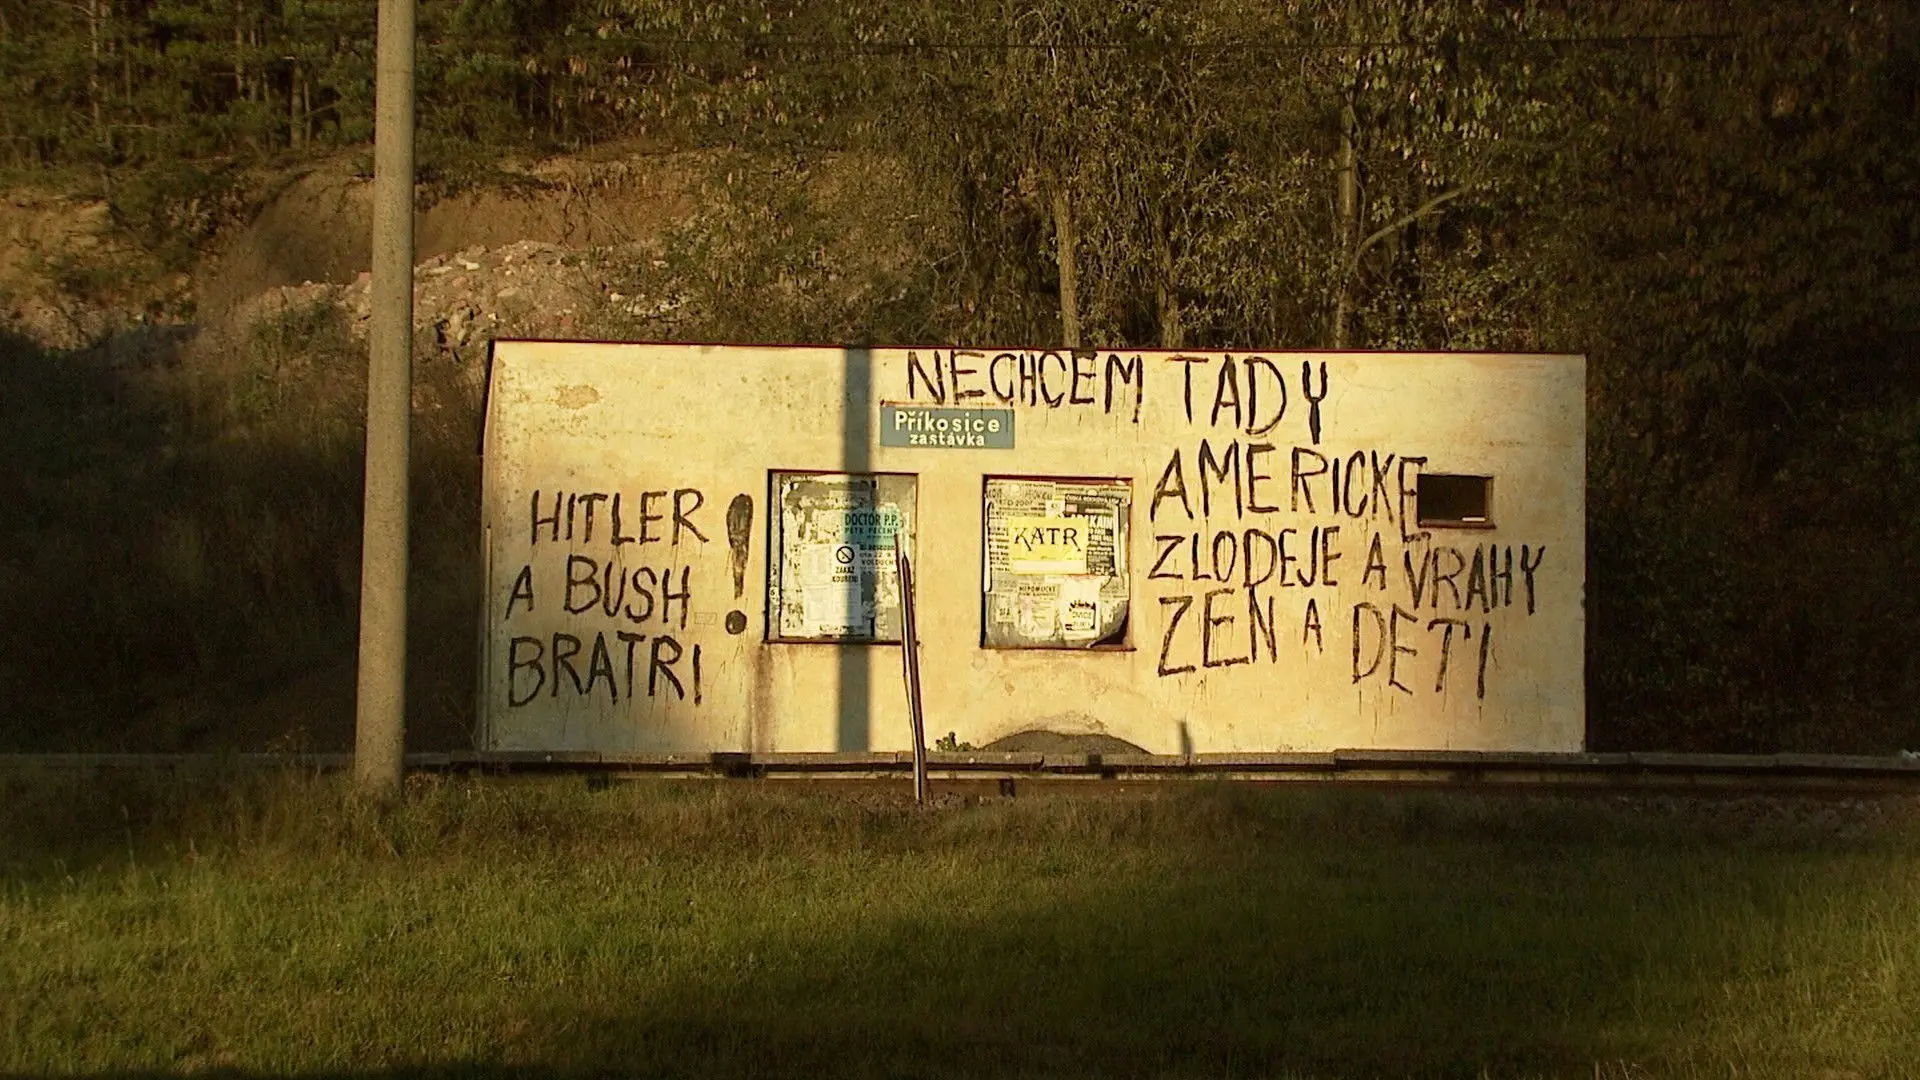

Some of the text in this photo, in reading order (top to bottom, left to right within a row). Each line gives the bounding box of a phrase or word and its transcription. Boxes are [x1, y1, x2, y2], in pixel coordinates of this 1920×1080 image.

[895, 410, 1000, 433] Příkosice
[907, 350, 1328, 445] NECHCEM TADY
[909, 432, 985, 447] zastávka
[530, 488, 709, 546] HITLER
[844, 513, 880, 526] DOCTOR
[1151, 438, 1430, 543] AMERICKE
[1014, 527, 1082, 552] KATR
[1147, 526, 1342, 589] ZLODEJE
[1362, 532, 1387, 591] A
[1403, 543, 1546, 616] VRAHY
[504, 554, 691, 631] A BUSH
[1157, 586, 1278, 678] ZEN
[1302, 598, 1324, 655] A
